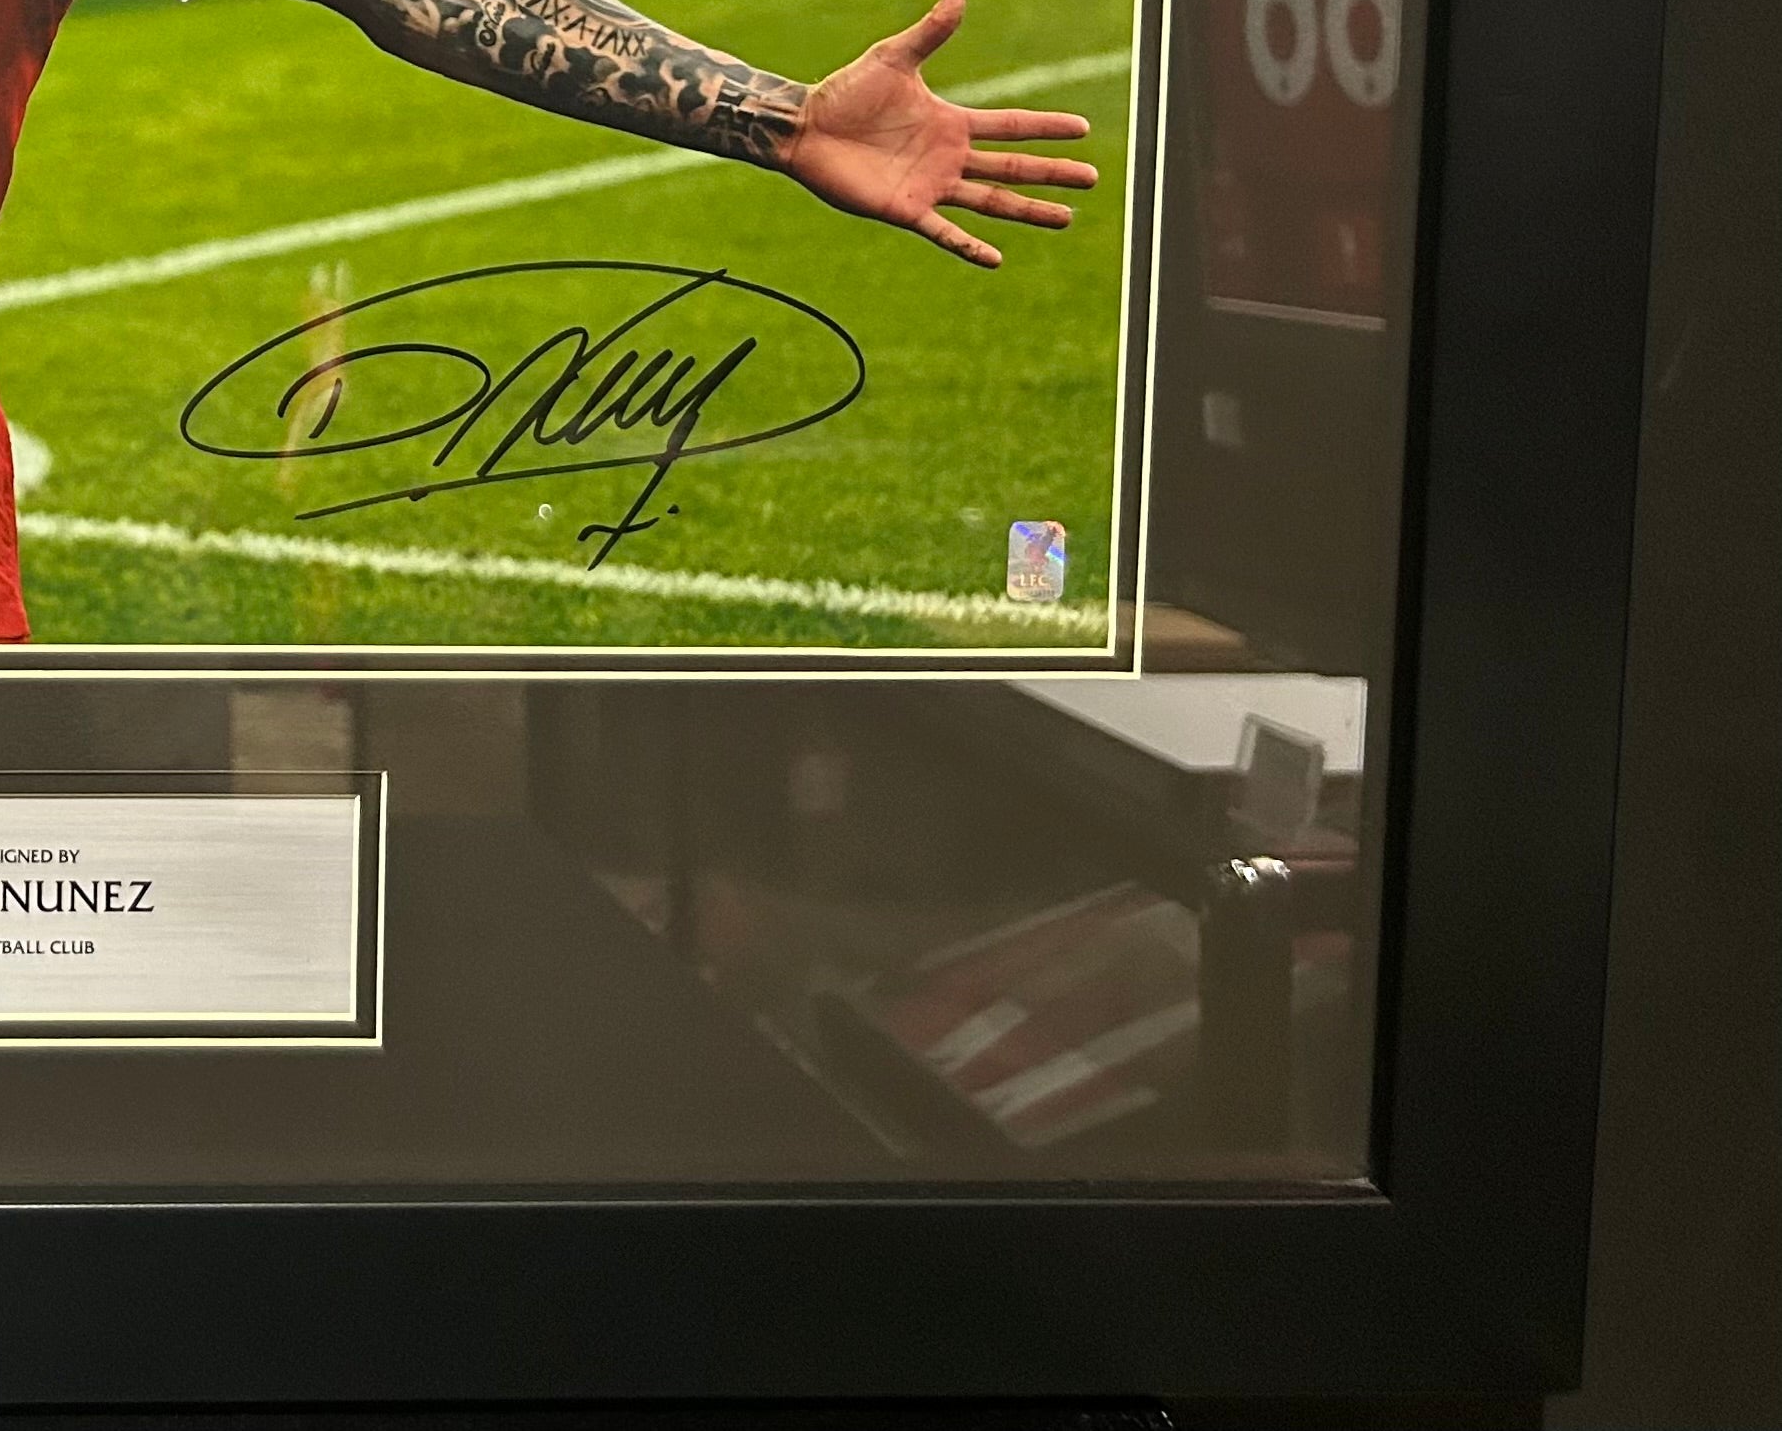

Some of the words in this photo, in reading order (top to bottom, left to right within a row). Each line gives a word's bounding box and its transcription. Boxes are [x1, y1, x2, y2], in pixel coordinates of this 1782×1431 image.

[52, 849, 80, 864] BY
[0, 880, 155, 913] NUNEZ
[50, 940, 95, 955] CLUB
